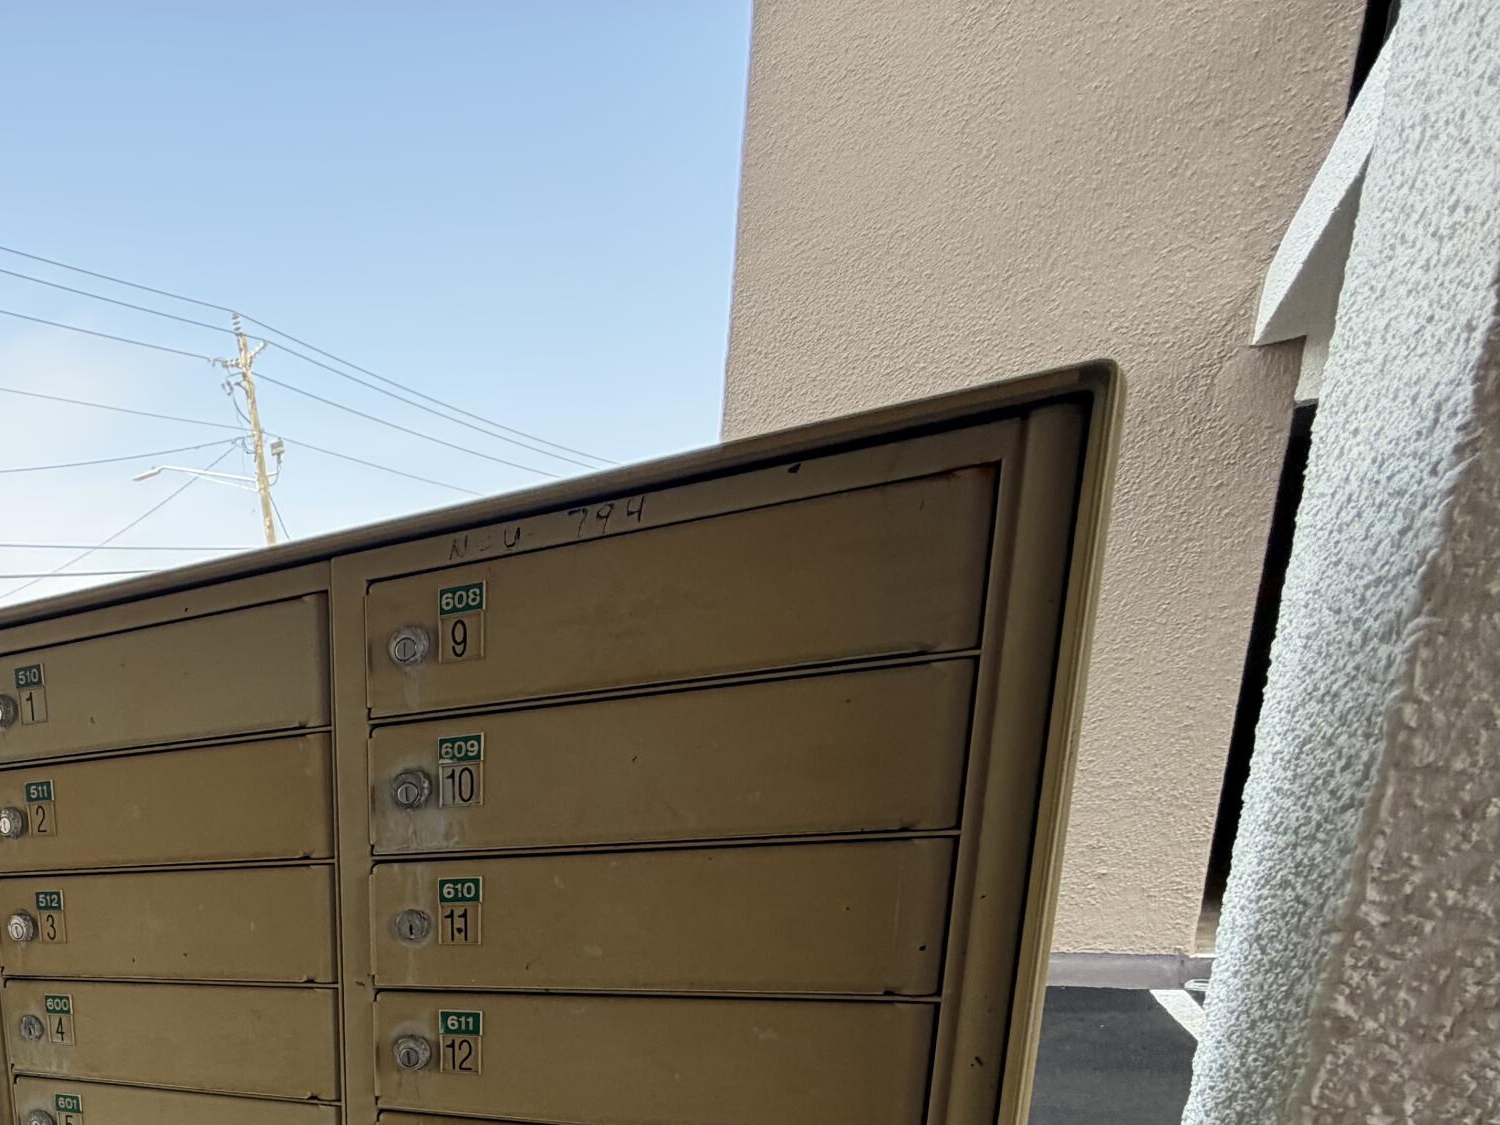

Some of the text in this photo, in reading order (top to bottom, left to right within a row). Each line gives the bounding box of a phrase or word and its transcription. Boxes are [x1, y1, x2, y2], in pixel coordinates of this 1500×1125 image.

[442, 588, 481, 610] 608
[451, 619, 467, 657] 9
[17, 668, 39, 685] 510
[25, 691, 35, 721] 1
[441, 740, 479, 758] 609
[29, 784, 48, 798] 511
[445, 767, 474, 803] 10
[35, 804, 48, 833] 2
[37, 894, 60, 907] 512
[442, 882, 476, 899] 610
[45, 913, 57, 941] 3
[443, 908, 468, 941] 11
[46, 998, 69, 1011] 600
[56, 1016, 65, 1041] 4
[446, 1015, 475, 1030] 611
[445, 1038, 473, 1071] 12
[57, 1098, 78, 1109] 601
